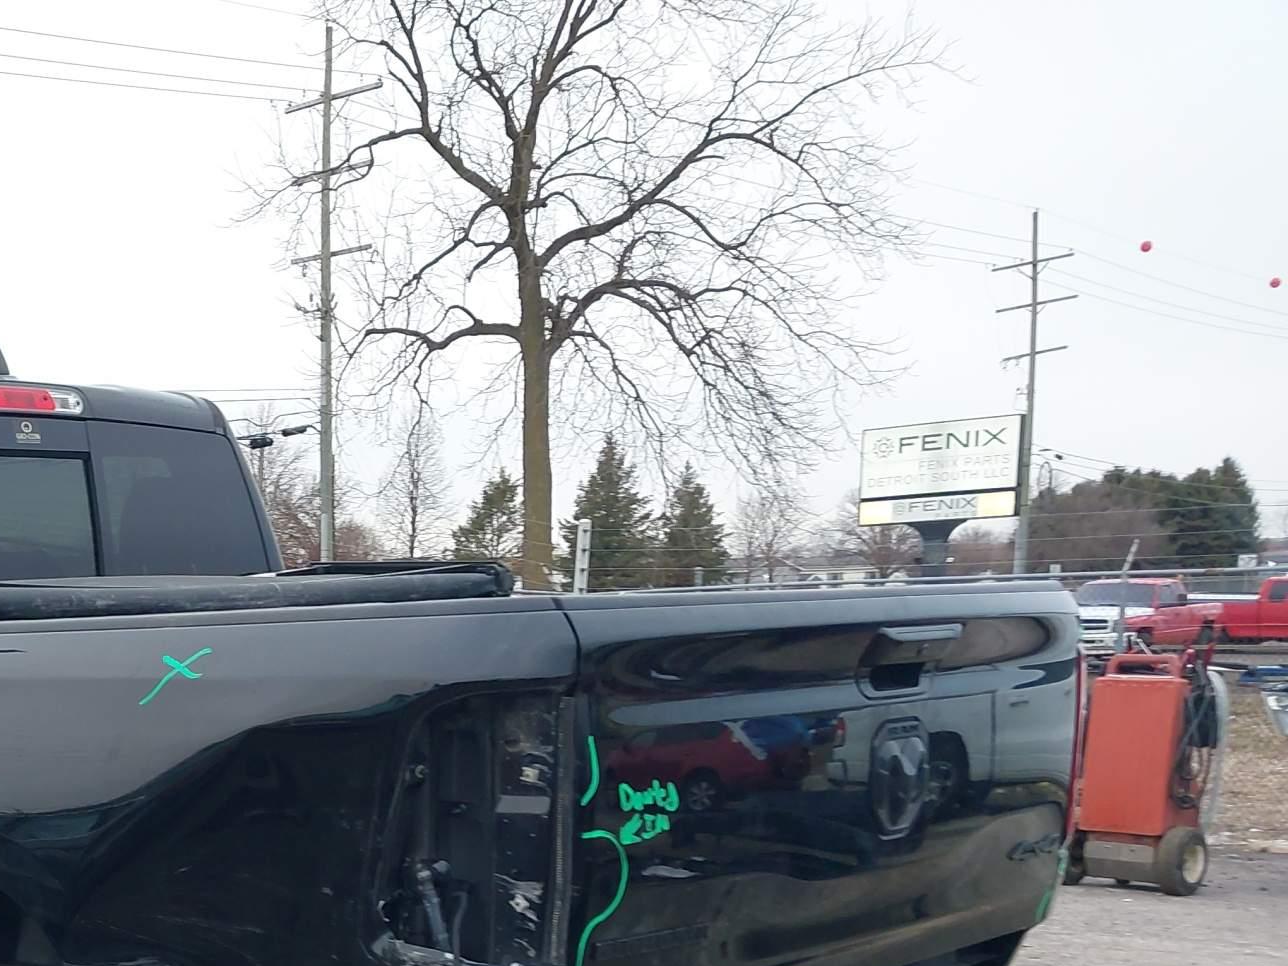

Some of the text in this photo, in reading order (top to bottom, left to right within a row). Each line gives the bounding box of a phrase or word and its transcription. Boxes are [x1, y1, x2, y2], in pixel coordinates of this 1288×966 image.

[898, 427, 1008, 454] FENIX
[964, 454, 1010, 466] PARTS
[931, 469, 978, 483] SOUTH
[983, 467, 1010, 479] LLC
[908, 496, 977, 513] FENIX
